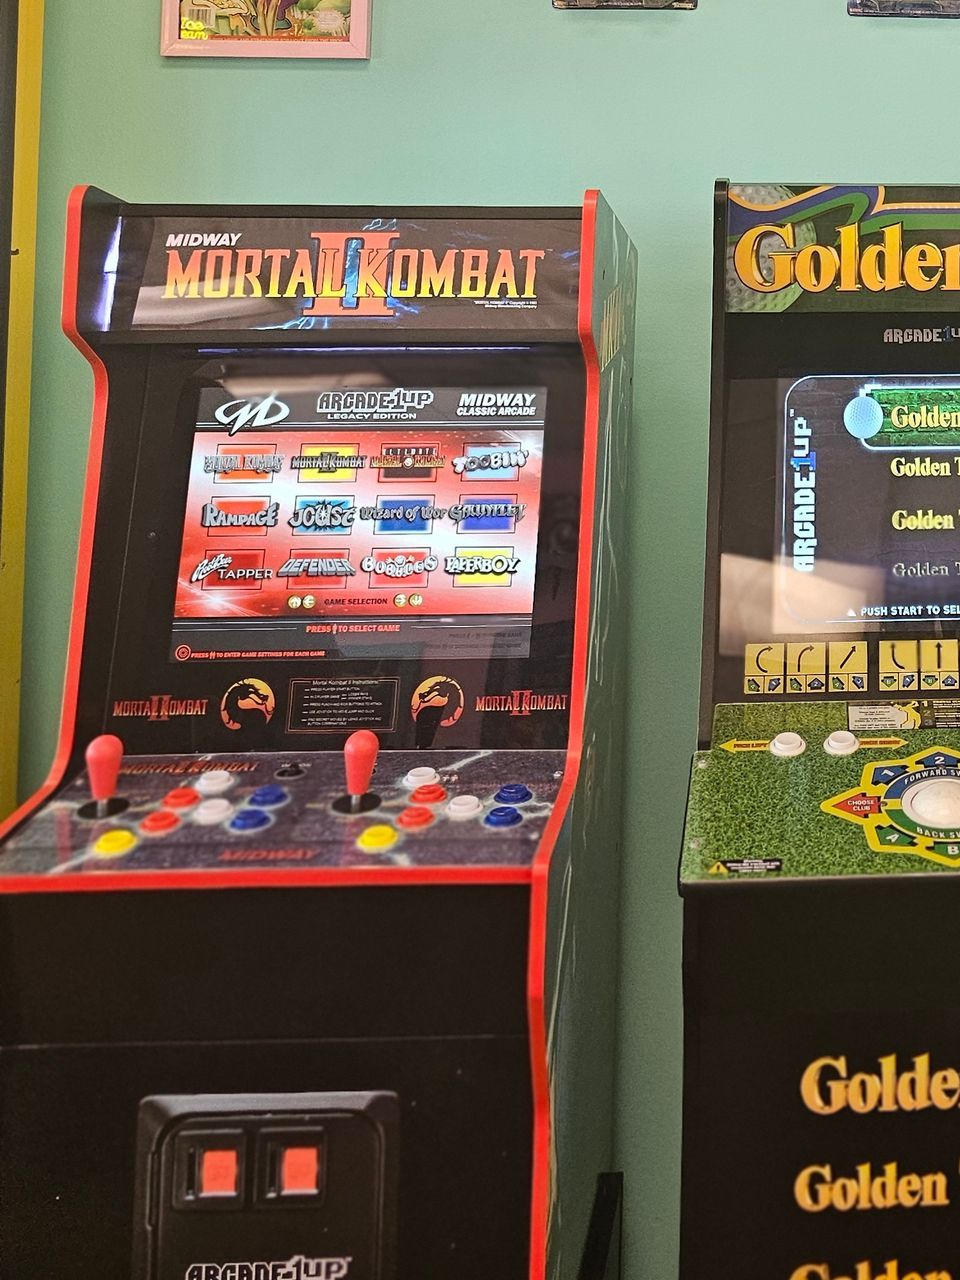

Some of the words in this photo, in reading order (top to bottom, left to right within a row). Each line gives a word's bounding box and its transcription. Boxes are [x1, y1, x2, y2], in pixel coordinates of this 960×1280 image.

[165, 232, 242, 248] MIDWAY
[160, 249, 352, 300] MORTAL
[353, 248, 546, 300] KOMBAT
[458, 393, 536, 407] MIDWAY
[456, 407, 493, 416] CLASSIC
[494, 407, 536, 416] ARCADE
[890, 457, 952, 478] Golden
[202, 502, 280, 527] RAMPAGE
[360, 506, 404, 520] Wizard
[405, 505, 420, 522] of
[421, 505, 449, 520] Wor
[891, 509, 955, 531] Golden
[276, 557, 357, 577] DEFENDER
[444, 554, 522, 576] PAPERBOY
[892, 561, 950, 578] Golden
[219, 569, 274, 579] TAPPER
[324, 597, 346, 606] GAME
[347, 597, 388, 606] SELECTION
[860, 607, 888, 617] PUSH
[890, 605, 923, 616] START
[925, 605, 941, 615] TO
[306, 625, 333, 633] PRESS
[337, 625, 348, 633] TO
[349, 624, 377, 633] SELECT
[377, 624, 400, 632] GAME
[934, 756, 946, 764] 2
[904, 769, 948, 785] FORWARD
[916, 826, 946, 839] BACK
[794, 1162, 949, 1212] Golden
